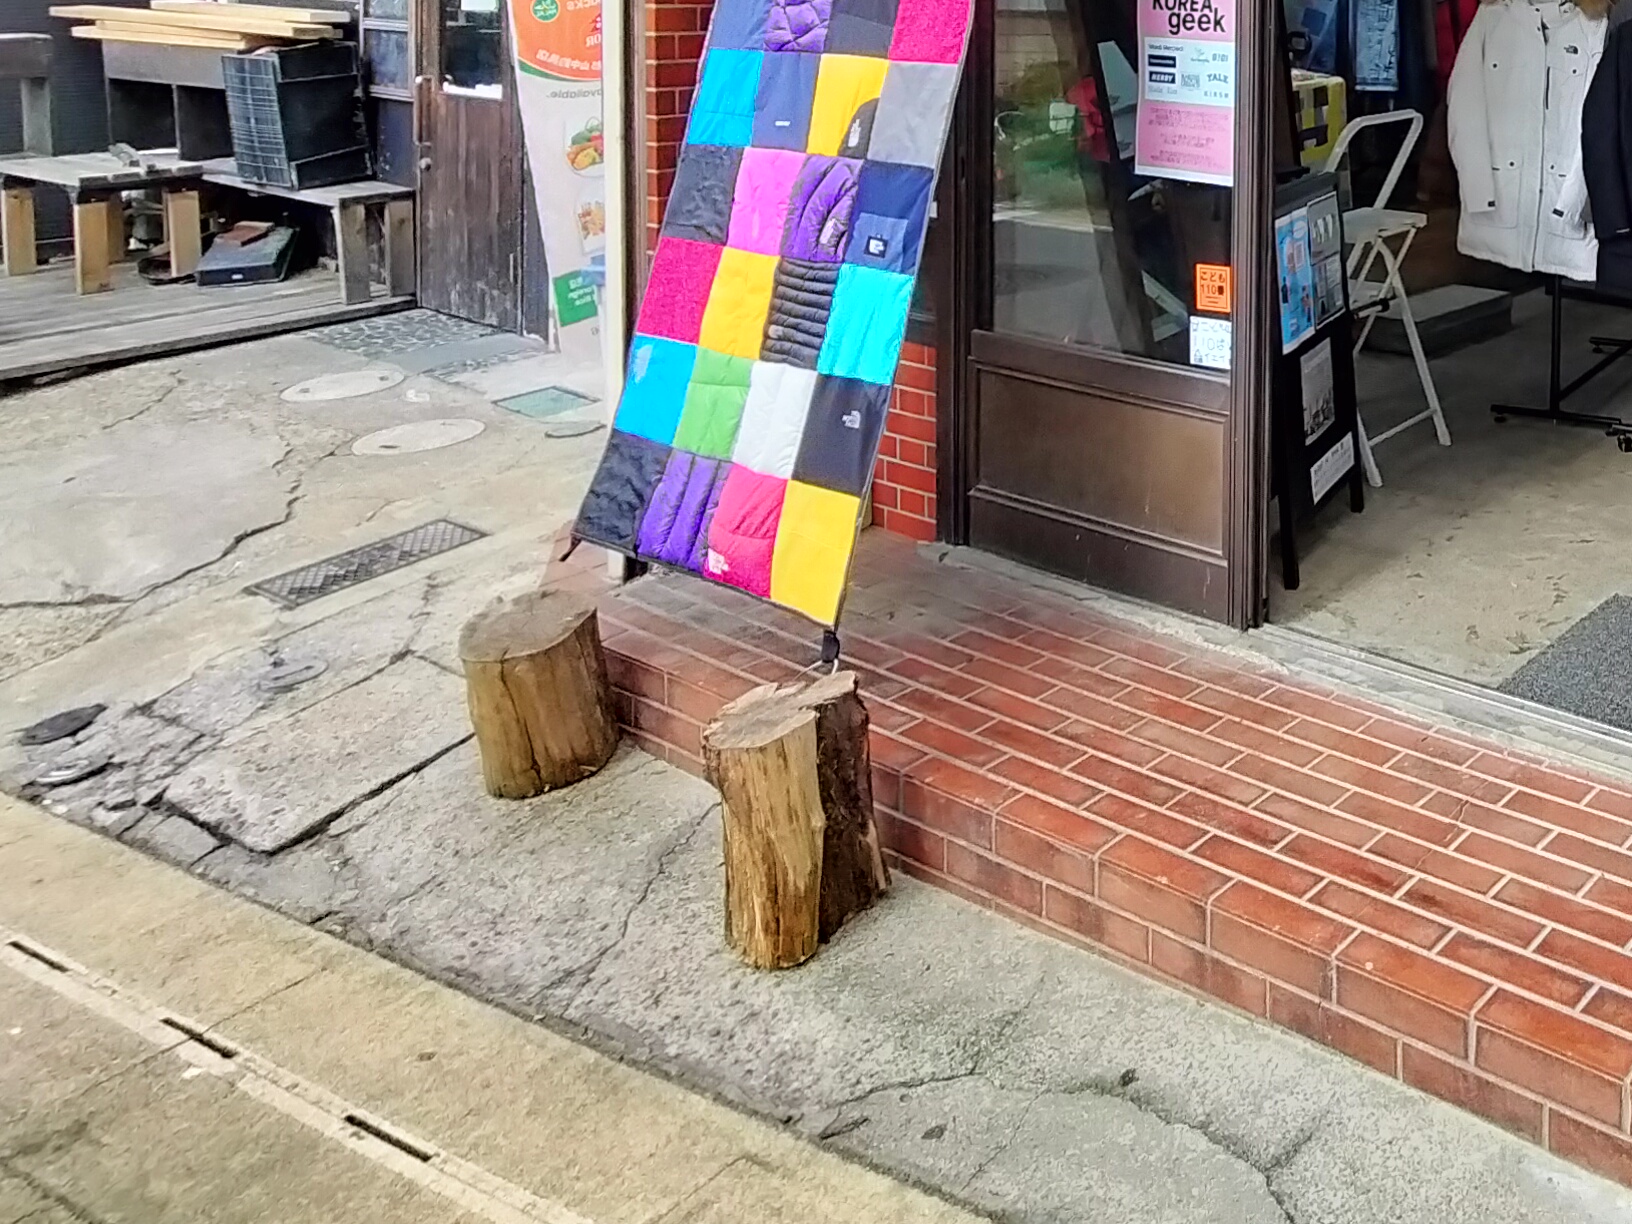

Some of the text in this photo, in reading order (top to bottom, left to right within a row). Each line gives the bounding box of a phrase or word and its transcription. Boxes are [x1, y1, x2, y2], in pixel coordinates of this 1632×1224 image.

[1168, 7, 1226, 36] geek
[1201, 272, 1225, 283] こども
